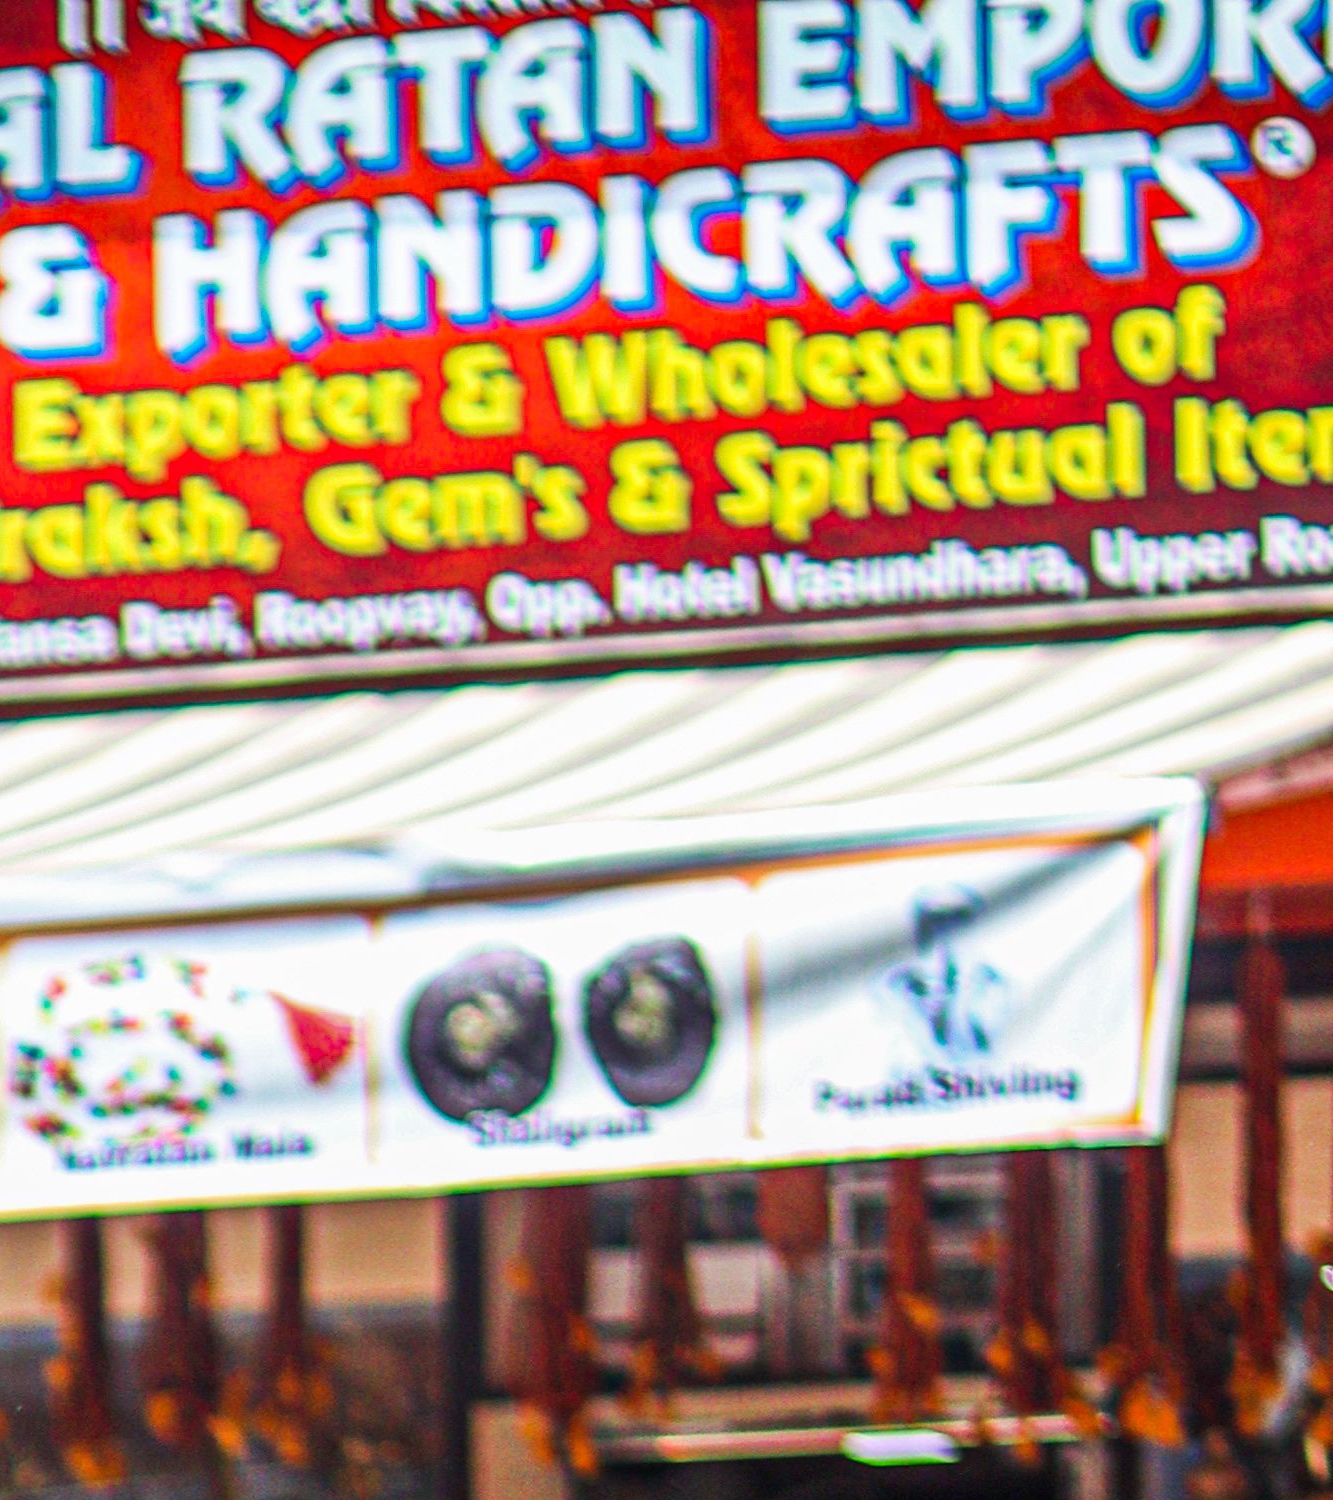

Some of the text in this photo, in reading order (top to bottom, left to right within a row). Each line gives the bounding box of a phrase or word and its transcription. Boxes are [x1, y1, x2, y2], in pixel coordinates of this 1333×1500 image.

[179, 7, 712, 194] RATAN
[759, 0, 1333, 133] EMPOR
[13, 283, 1227, 482] Exporter & Wholesaler of
[302, 454, 589, 556] Gem's
[608, 437, 693, 533] &
[717, 401, 1149, 541] Sprictual
[1174, 396, 1333, 493] Ite
[614, 553, 760, 620] Hotel
[1090, 525, 1257, 594] Upper
